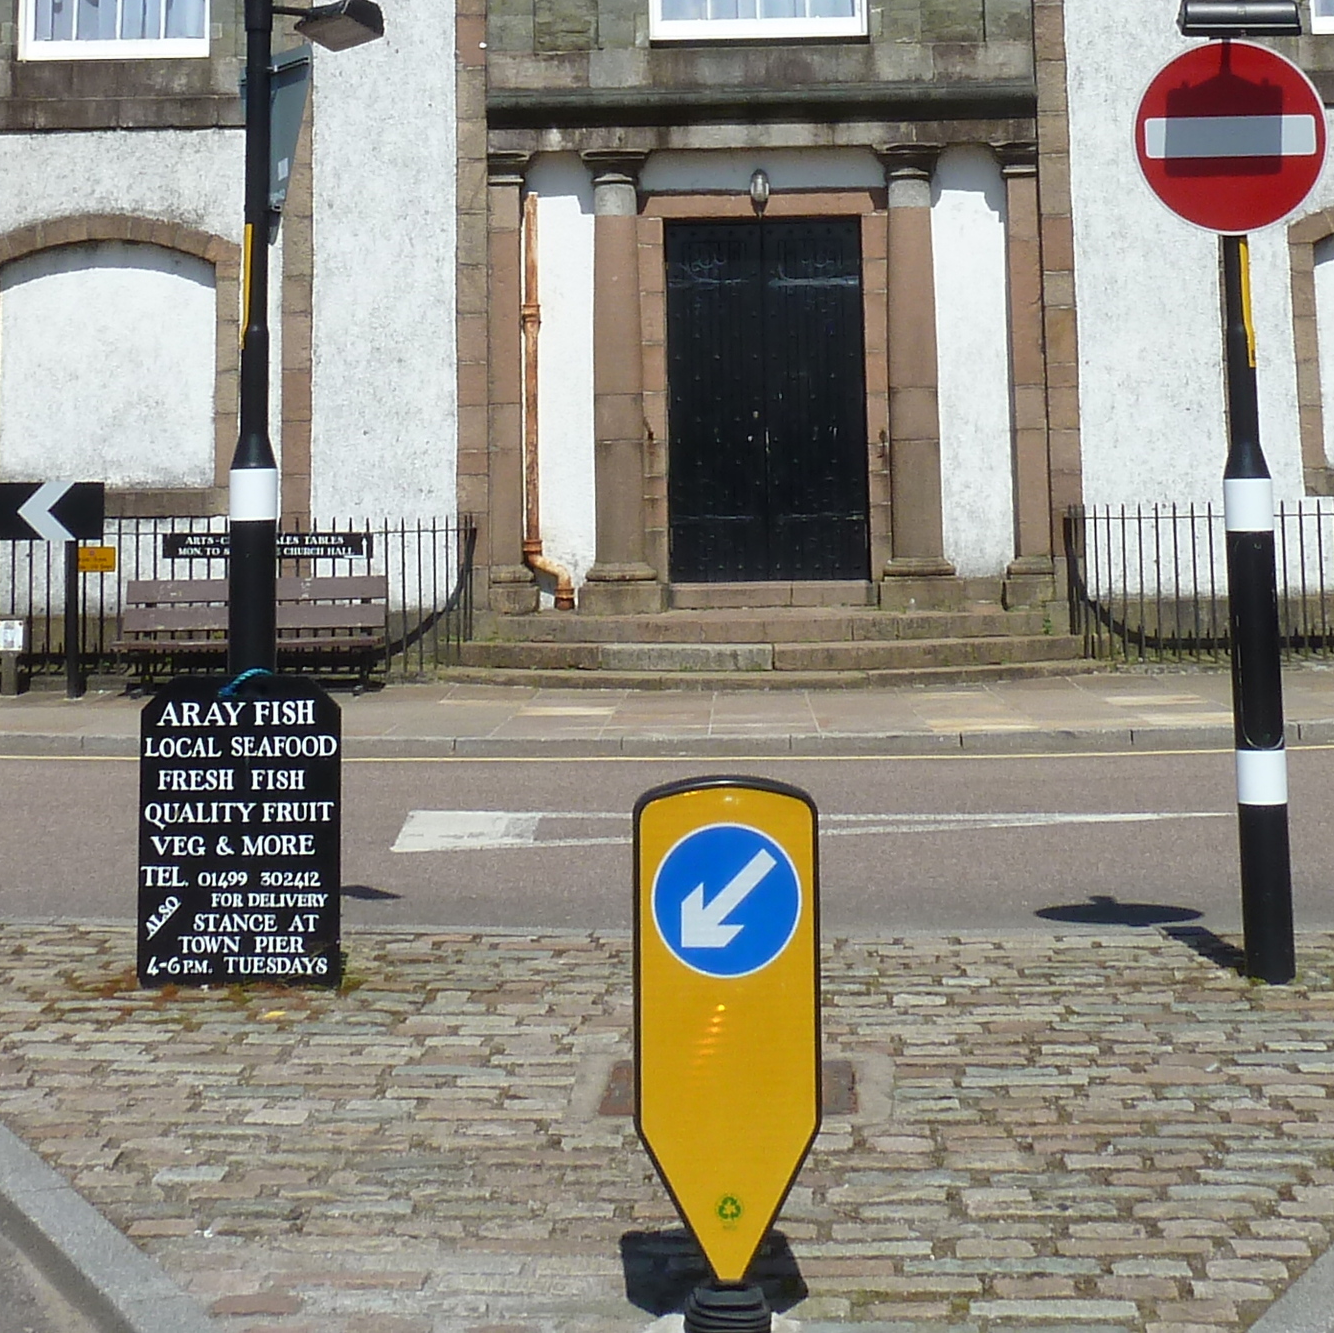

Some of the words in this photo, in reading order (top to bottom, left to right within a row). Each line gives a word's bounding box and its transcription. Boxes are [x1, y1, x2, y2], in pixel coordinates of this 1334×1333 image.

[304, 535, 345, 545] TABLES
[206, 547, 221, 556] TO
[283, 546, 324, 556] CHURCH
[327, 546, 354, 556] HALL
[156, 702, 246, 726] ARAY
[253, 700, 315, 725] FISH
[145, 737, 222, 757] LOCAL
[231, 736, 337, 757] SEAFOOD
[158, 770, 233, 790] FRESH
[252, 770, 304, 789] FISH
[145, 803, 256, 829] QUALITY
[262, 802, 334, 822] FRUIT
[151, 836, 205, 855] VEG
[216, 836, 234, 855] &
[242, 835, 315, 855] MORE
[141, 866, 188, 886] TEL.
[198, 872, 247, 888] 01499
[261, 872, 320, 889] 302412
[212, 893, 243, 907] FOR
[248, 893, 328, 907] DELIVERY
[145, 896, 180, 938] ALSO
[194, 914, 277, 932] STANCE
[288, 915, 319, 932] AT
[178, 936, 240, 953] TOWN
[255, 936, 304, 953] PIER
[224, 957, 327, 974] TUESDAYS
